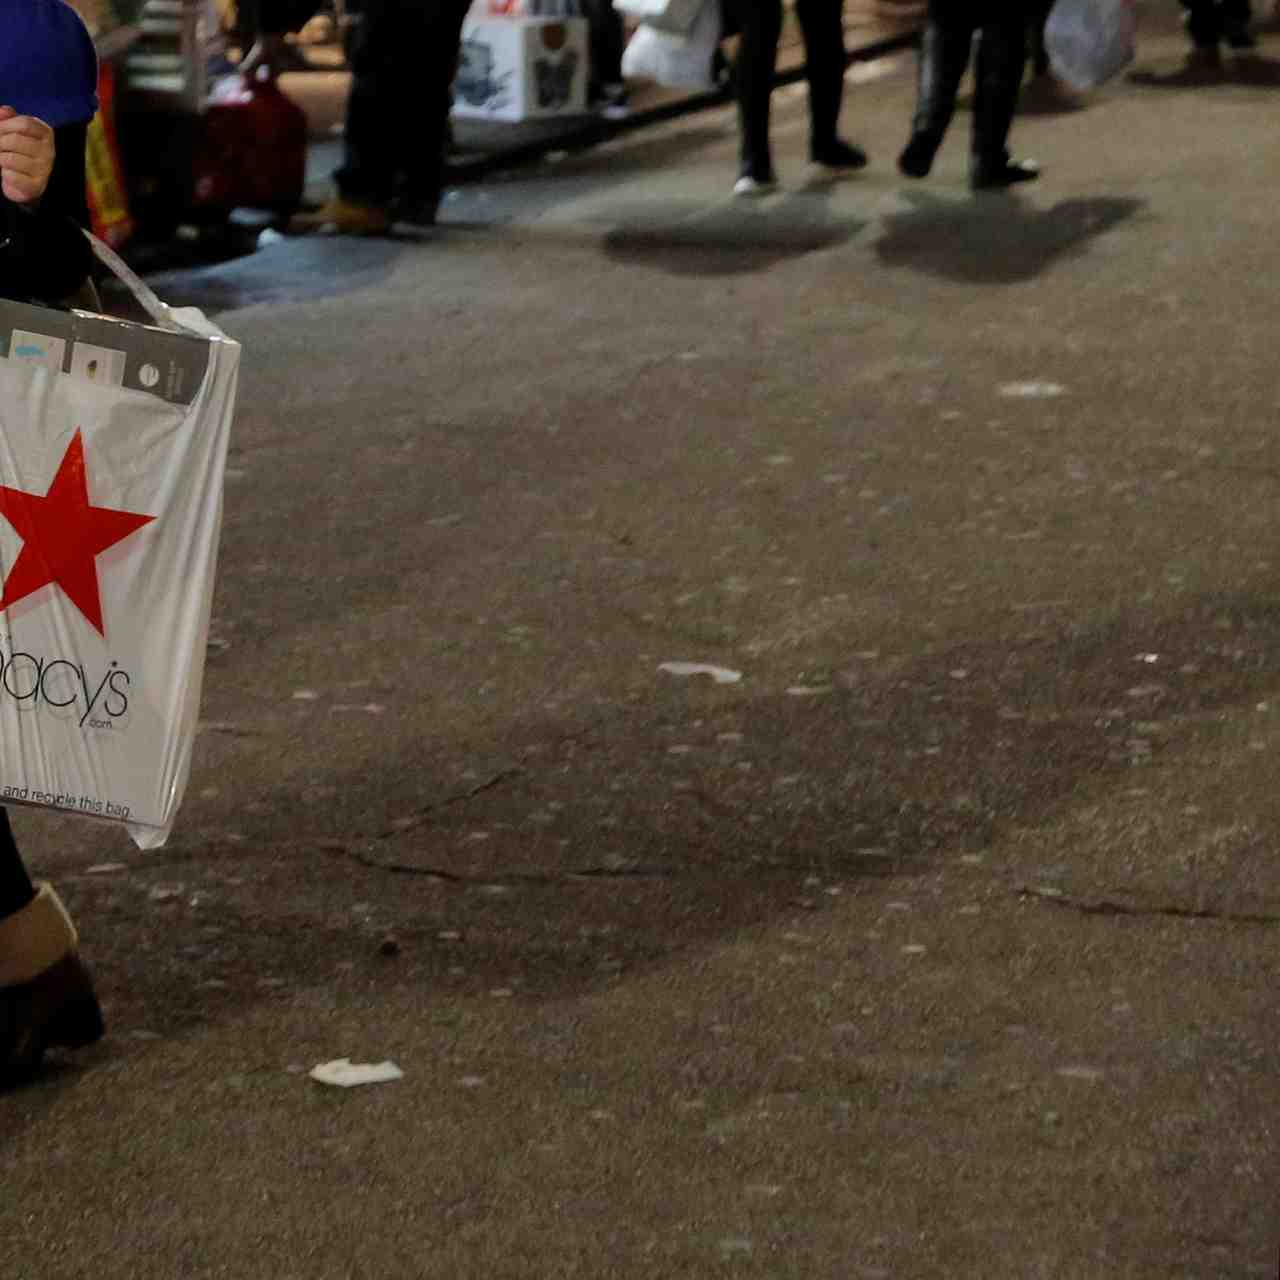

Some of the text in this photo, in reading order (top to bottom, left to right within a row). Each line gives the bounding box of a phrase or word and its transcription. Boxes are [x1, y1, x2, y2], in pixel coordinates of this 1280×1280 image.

[4, 785, 28, 800] and
[31, 790, 77, 808] recycle
[79, 795, 103, 812] this
